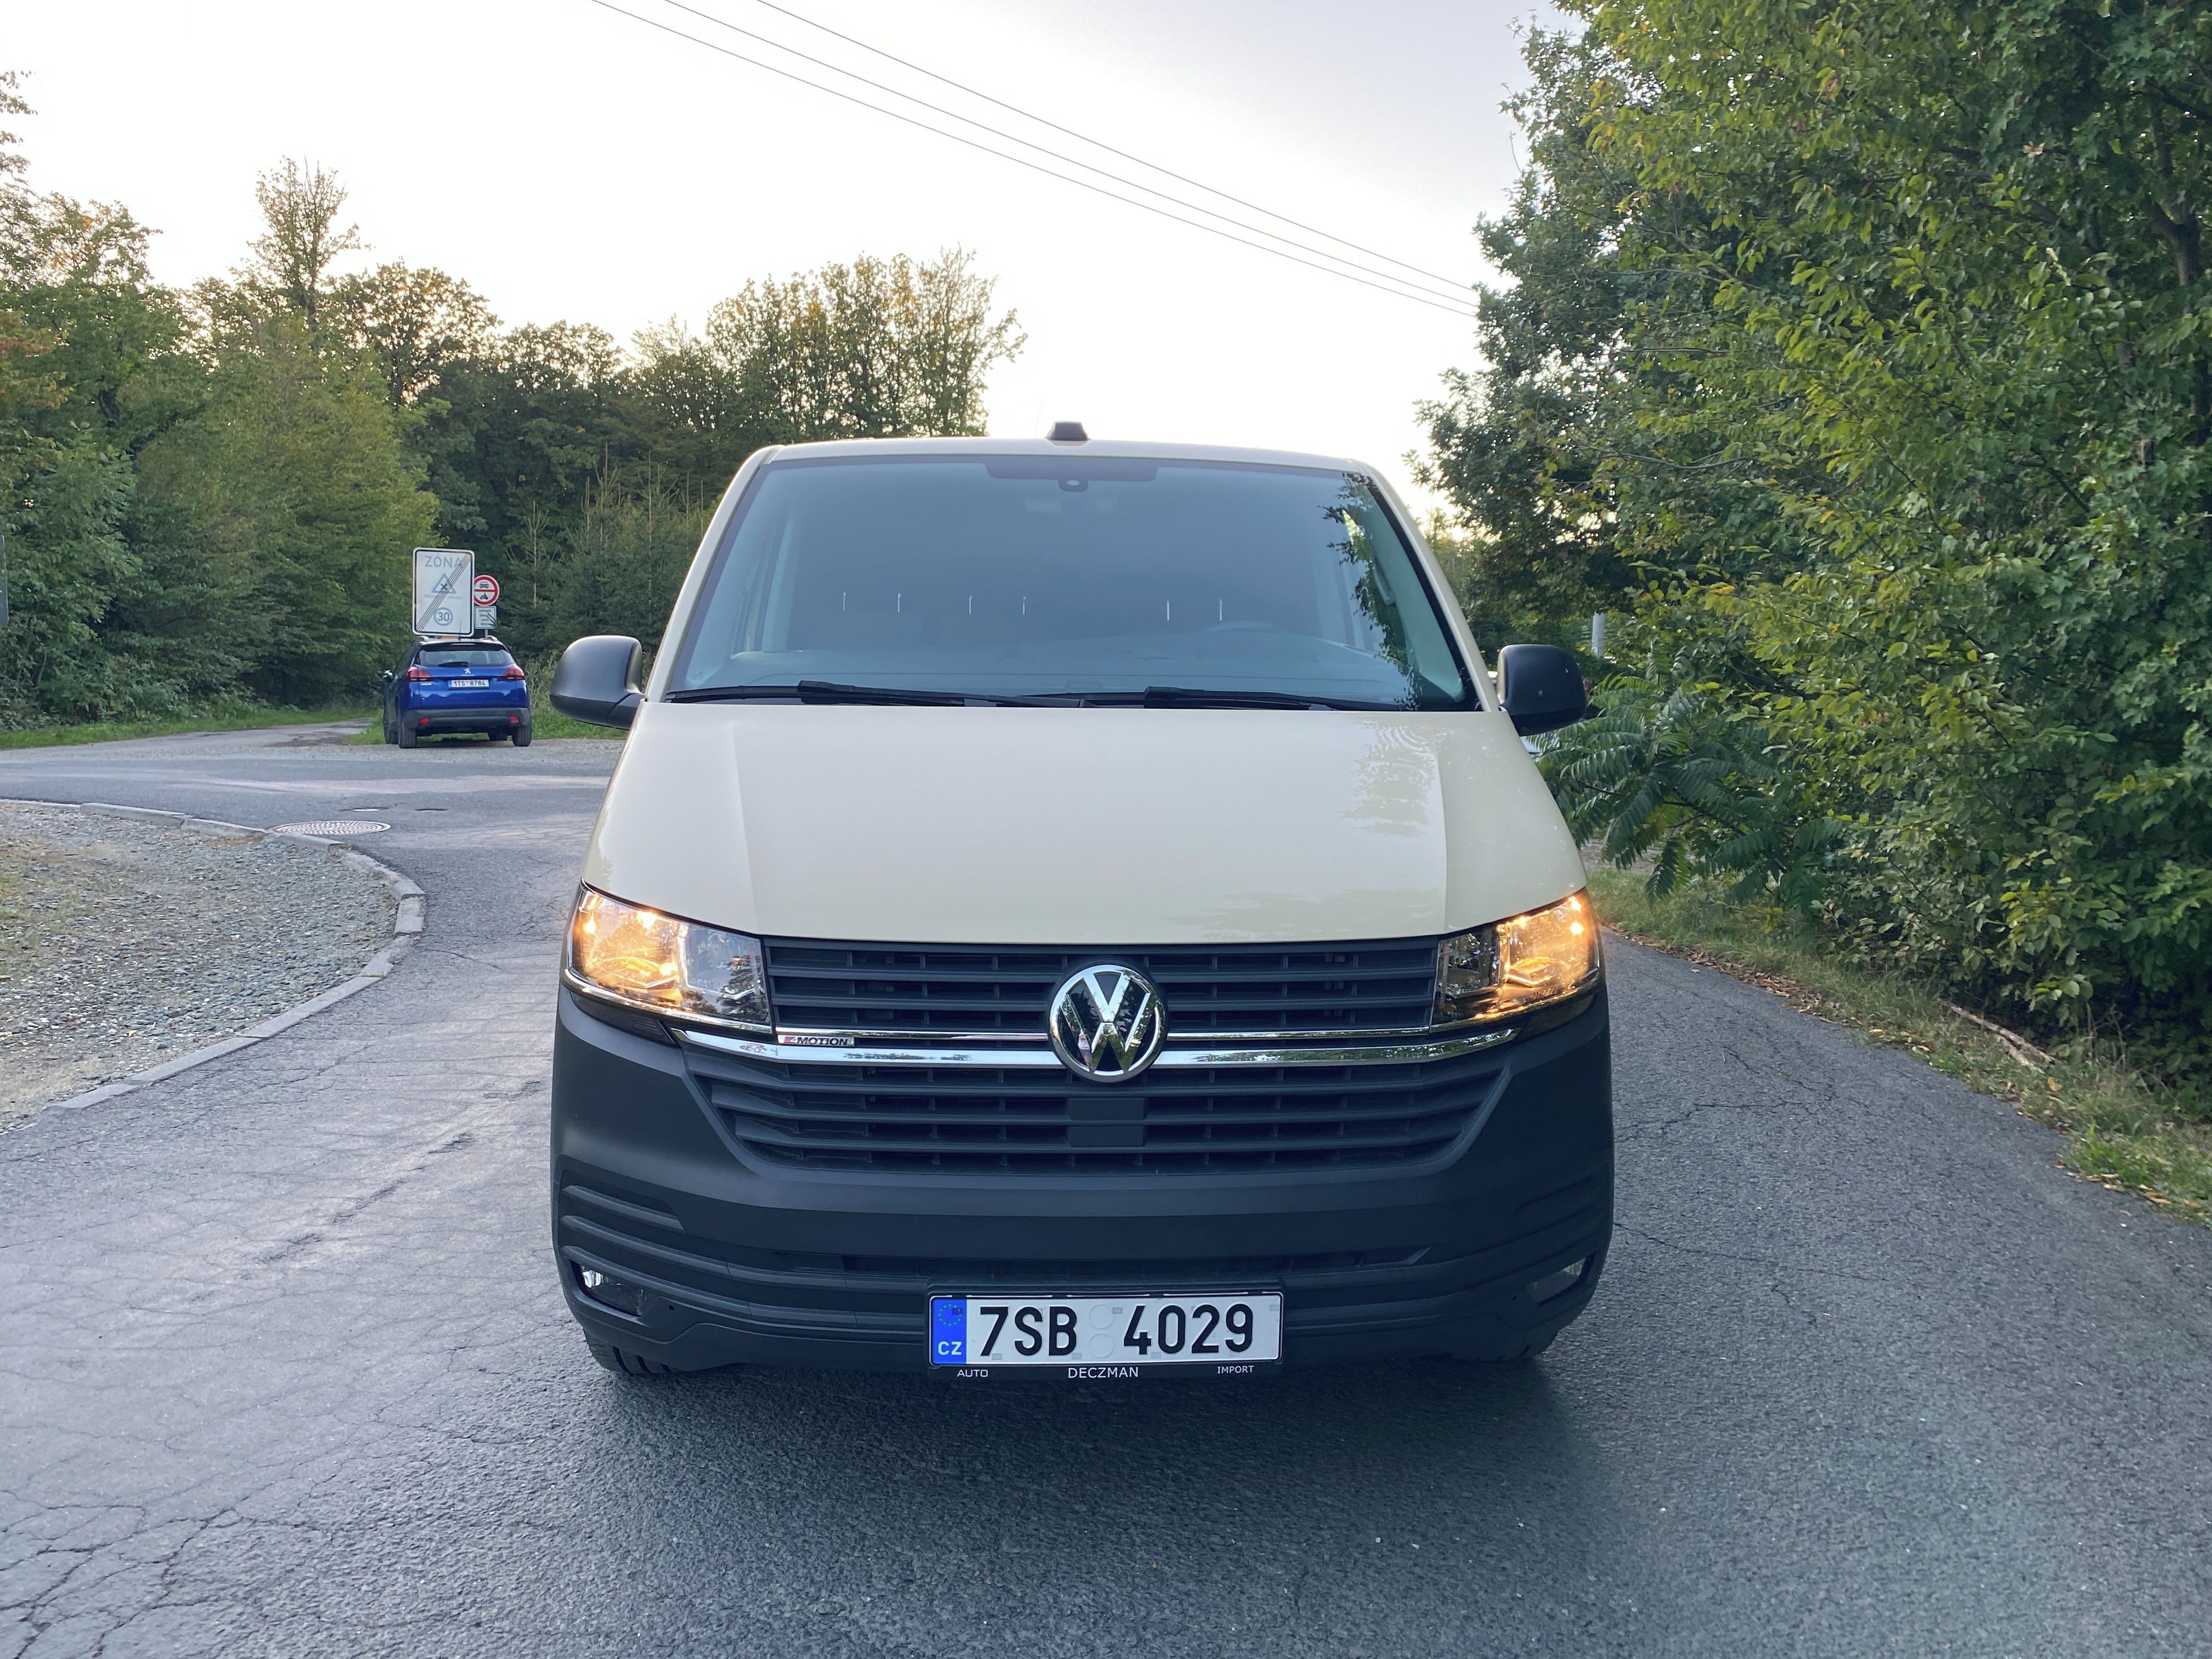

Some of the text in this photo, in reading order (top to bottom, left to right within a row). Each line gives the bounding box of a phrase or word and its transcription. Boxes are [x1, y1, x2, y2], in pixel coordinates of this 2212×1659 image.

[437, 612, 450, 622] 30
[980, 1303, 1254, 1357] 7SB 4029
[938, 1341, 962, 1356] CZ
[956, 1365, 1255, 1379] AUTO DECZMAN IMPORT
